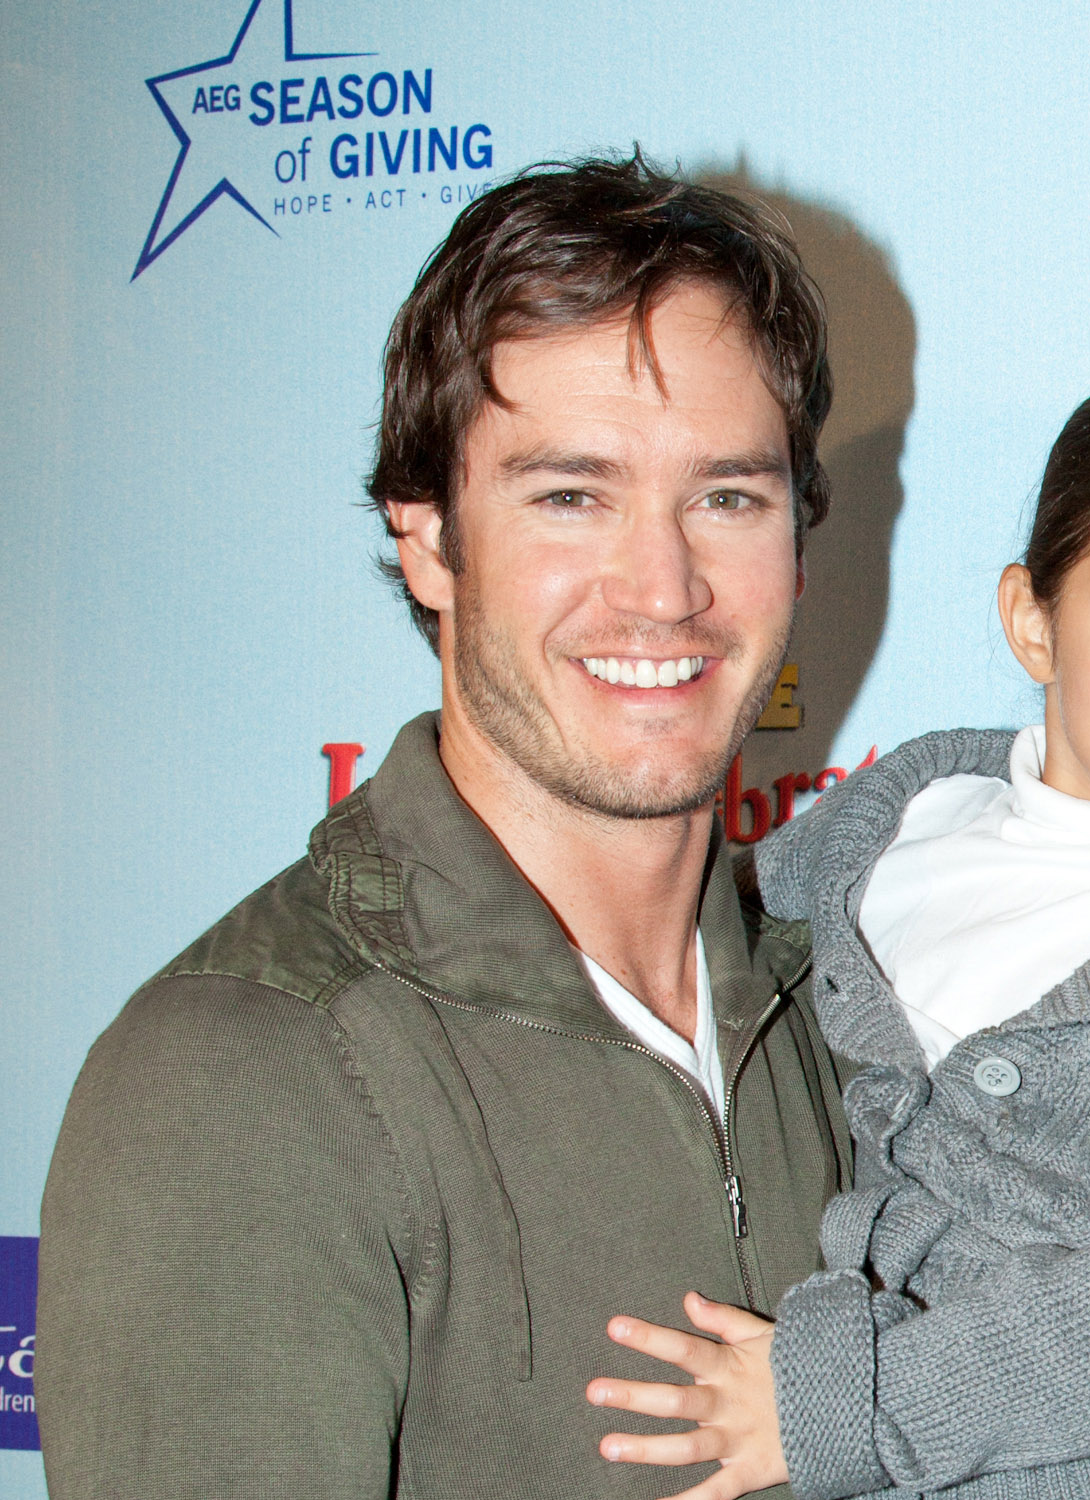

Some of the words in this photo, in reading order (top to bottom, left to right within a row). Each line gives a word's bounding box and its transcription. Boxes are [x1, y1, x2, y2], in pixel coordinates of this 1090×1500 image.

[192, 84, 241, 114] AEG
[249, 68, 432, 126] SEASON
[275, 137, 313, 183] of
[330, 124, 493, 179] GIVING
[274, 194, 332, 216] HOPE
[365, 189, 407, 210] ACT
